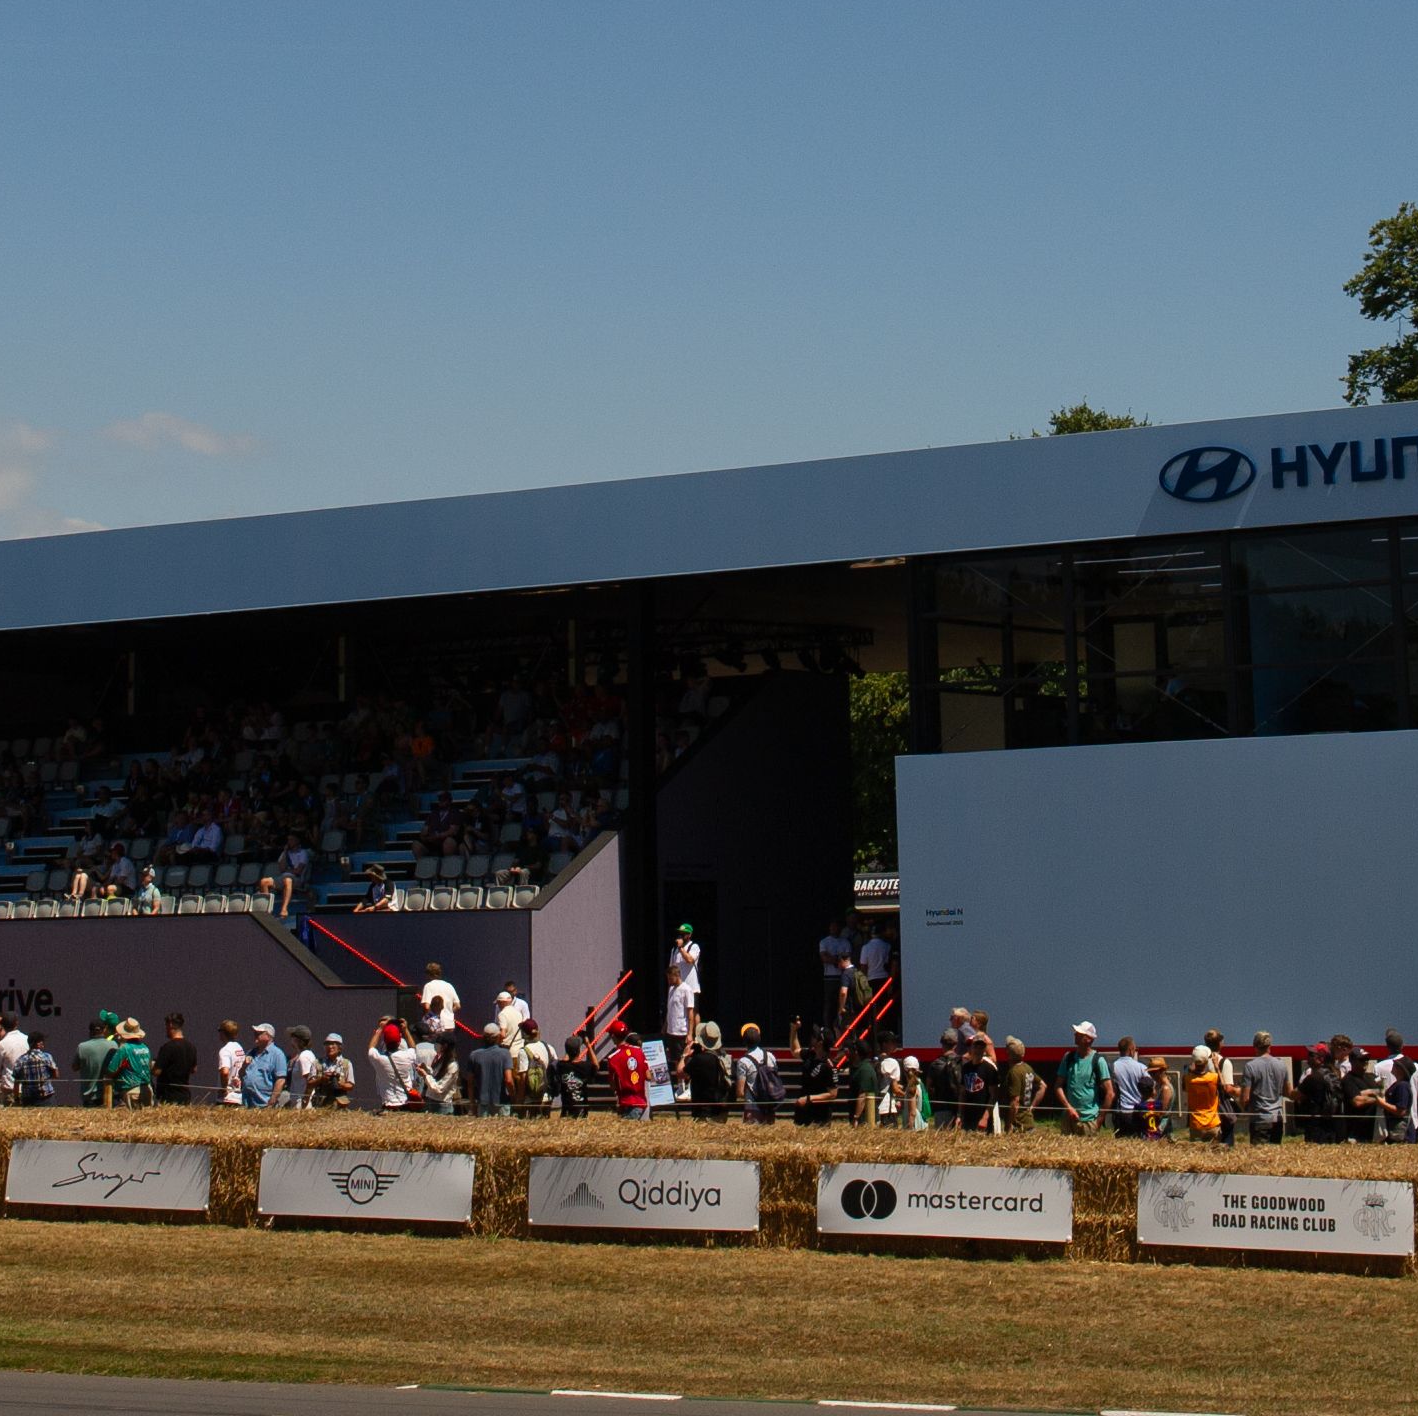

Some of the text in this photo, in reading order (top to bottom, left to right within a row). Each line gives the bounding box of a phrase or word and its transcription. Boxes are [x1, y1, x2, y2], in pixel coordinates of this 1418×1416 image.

[52, 1152, 161, 1200] Singer
[350, 1179, 375, 1190] MINI
[618, 1178, 721, 1212] Qiddiya
[907, 1191, 1044, 1213] mastercard
[1222, 1194, 1325, 1212] THE GOODWOOD
[1212, 1213, 1336, 1233] ROAD RACING CLUB
